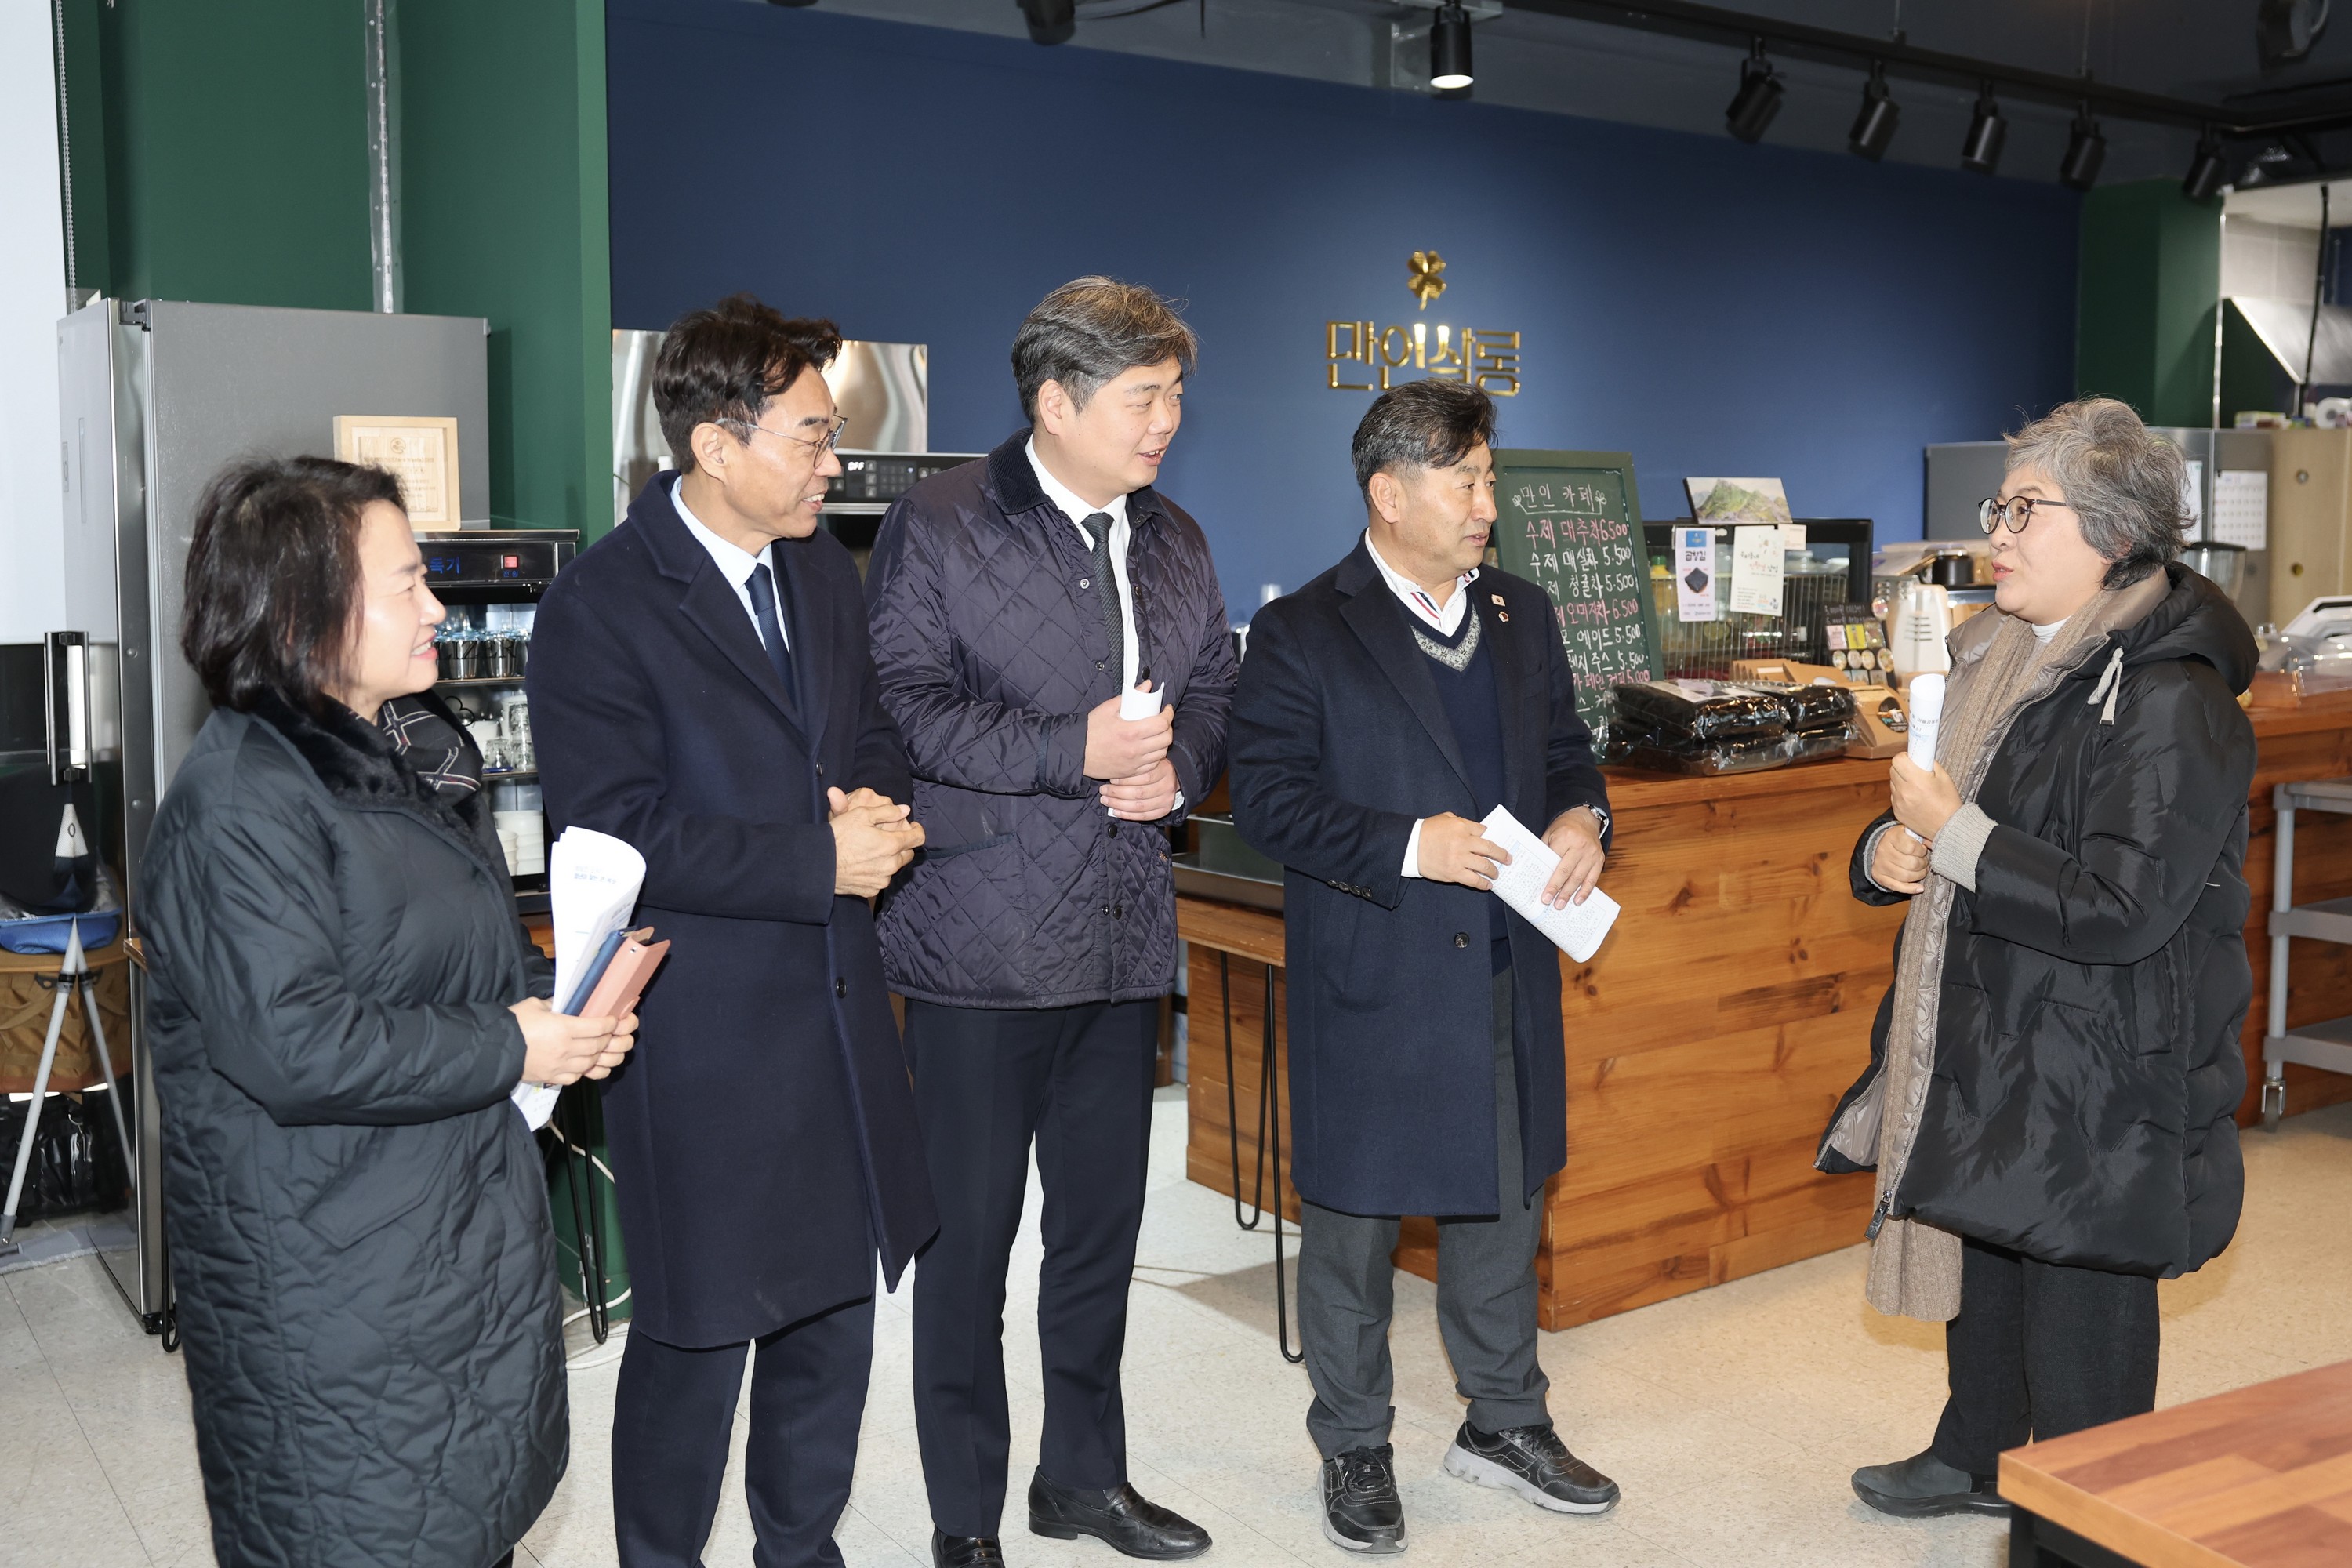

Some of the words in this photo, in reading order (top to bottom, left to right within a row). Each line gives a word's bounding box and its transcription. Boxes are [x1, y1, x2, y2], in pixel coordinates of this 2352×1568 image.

[848, 461, 865, 471] OFF
[1520, 483, 1555, 508] 만인
[1563, 483, 1595, 512] 카페
[1526, 518, 1556, 550] 수제
[1560, 517, 1601, 546] 대추차
[429, 557, 461, 575] 독기
[1530, 551, 1559, 578] 수제
[1562, 547, 1599, 573] 매실차
[1602, 543, 1632, 566] 5.500
[1537, 580, 1560, 601] 제
[1569, 572, 1604, 599] 청귤차
[1605, 573, 1635, 593] 5.500
[1554, 604, 1566, 627] 제
[1566, 598, 1611, 626] 오미자차
[1612, 598, 1639, 620] 6.500
[434, 637, 517, 660] LIZER
[1577, 627, 1613, 652] 에이드
[1615, 623, 1641, 644] 5.500
[1591, 652, 1614, 673] 주스
[1617, 649, 1645, 670] 5.500
